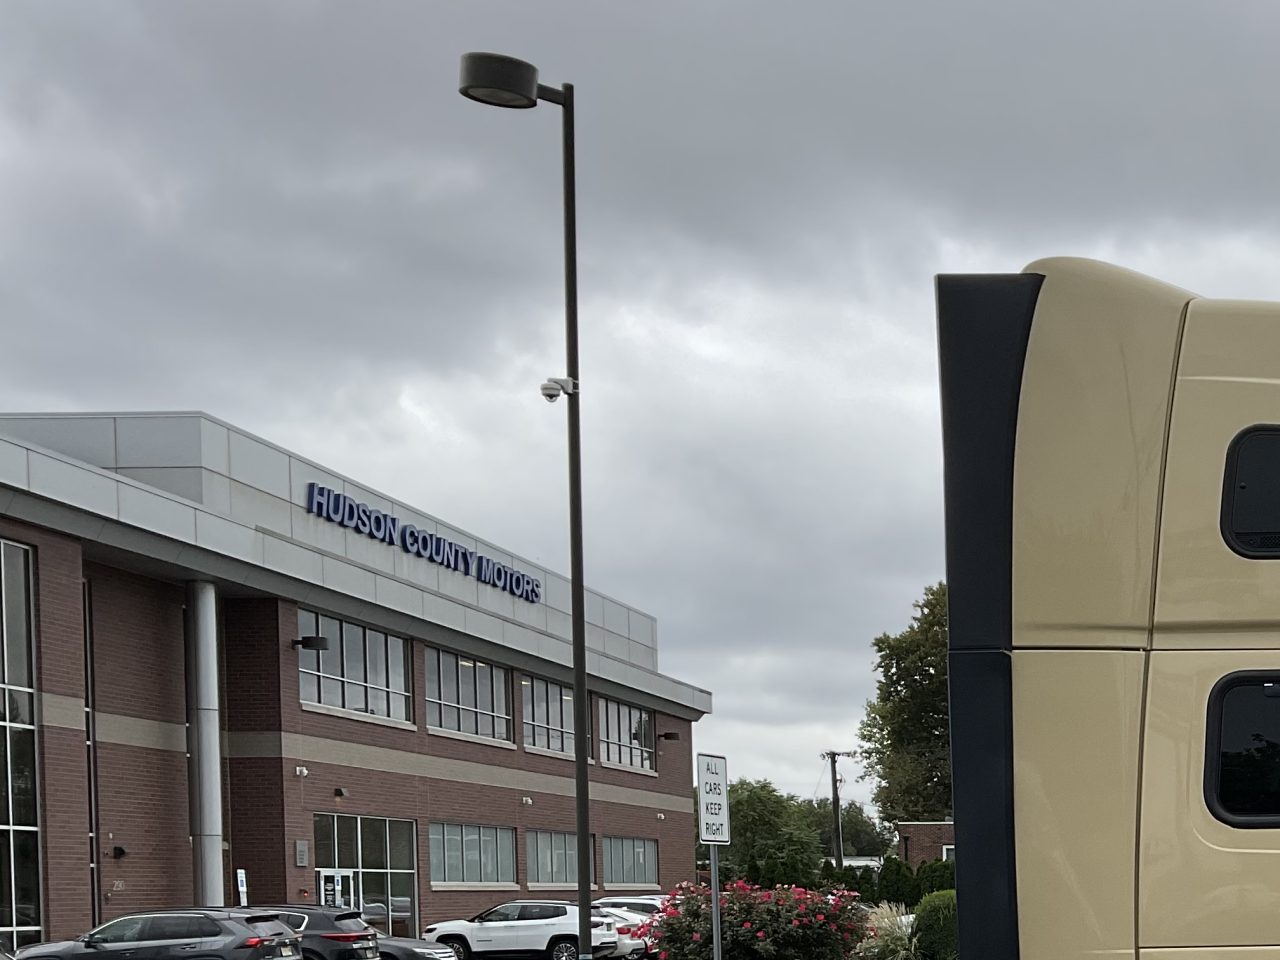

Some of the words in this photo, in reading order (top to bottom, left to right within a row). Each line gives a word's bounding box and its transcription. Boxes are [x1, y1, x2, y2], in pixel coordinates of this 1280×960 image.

[307, 482, 400, 546] HUDSON
[402, 524, 478, 576] COUNTY
[478, 556, 541, 603] MOTORS
[706, 761, 719, 775] ALL
[704, 782, 722, 796] CARS
[705, 802, 722, 816] KEEP
[705, 822, 724, 836] RIGHT
